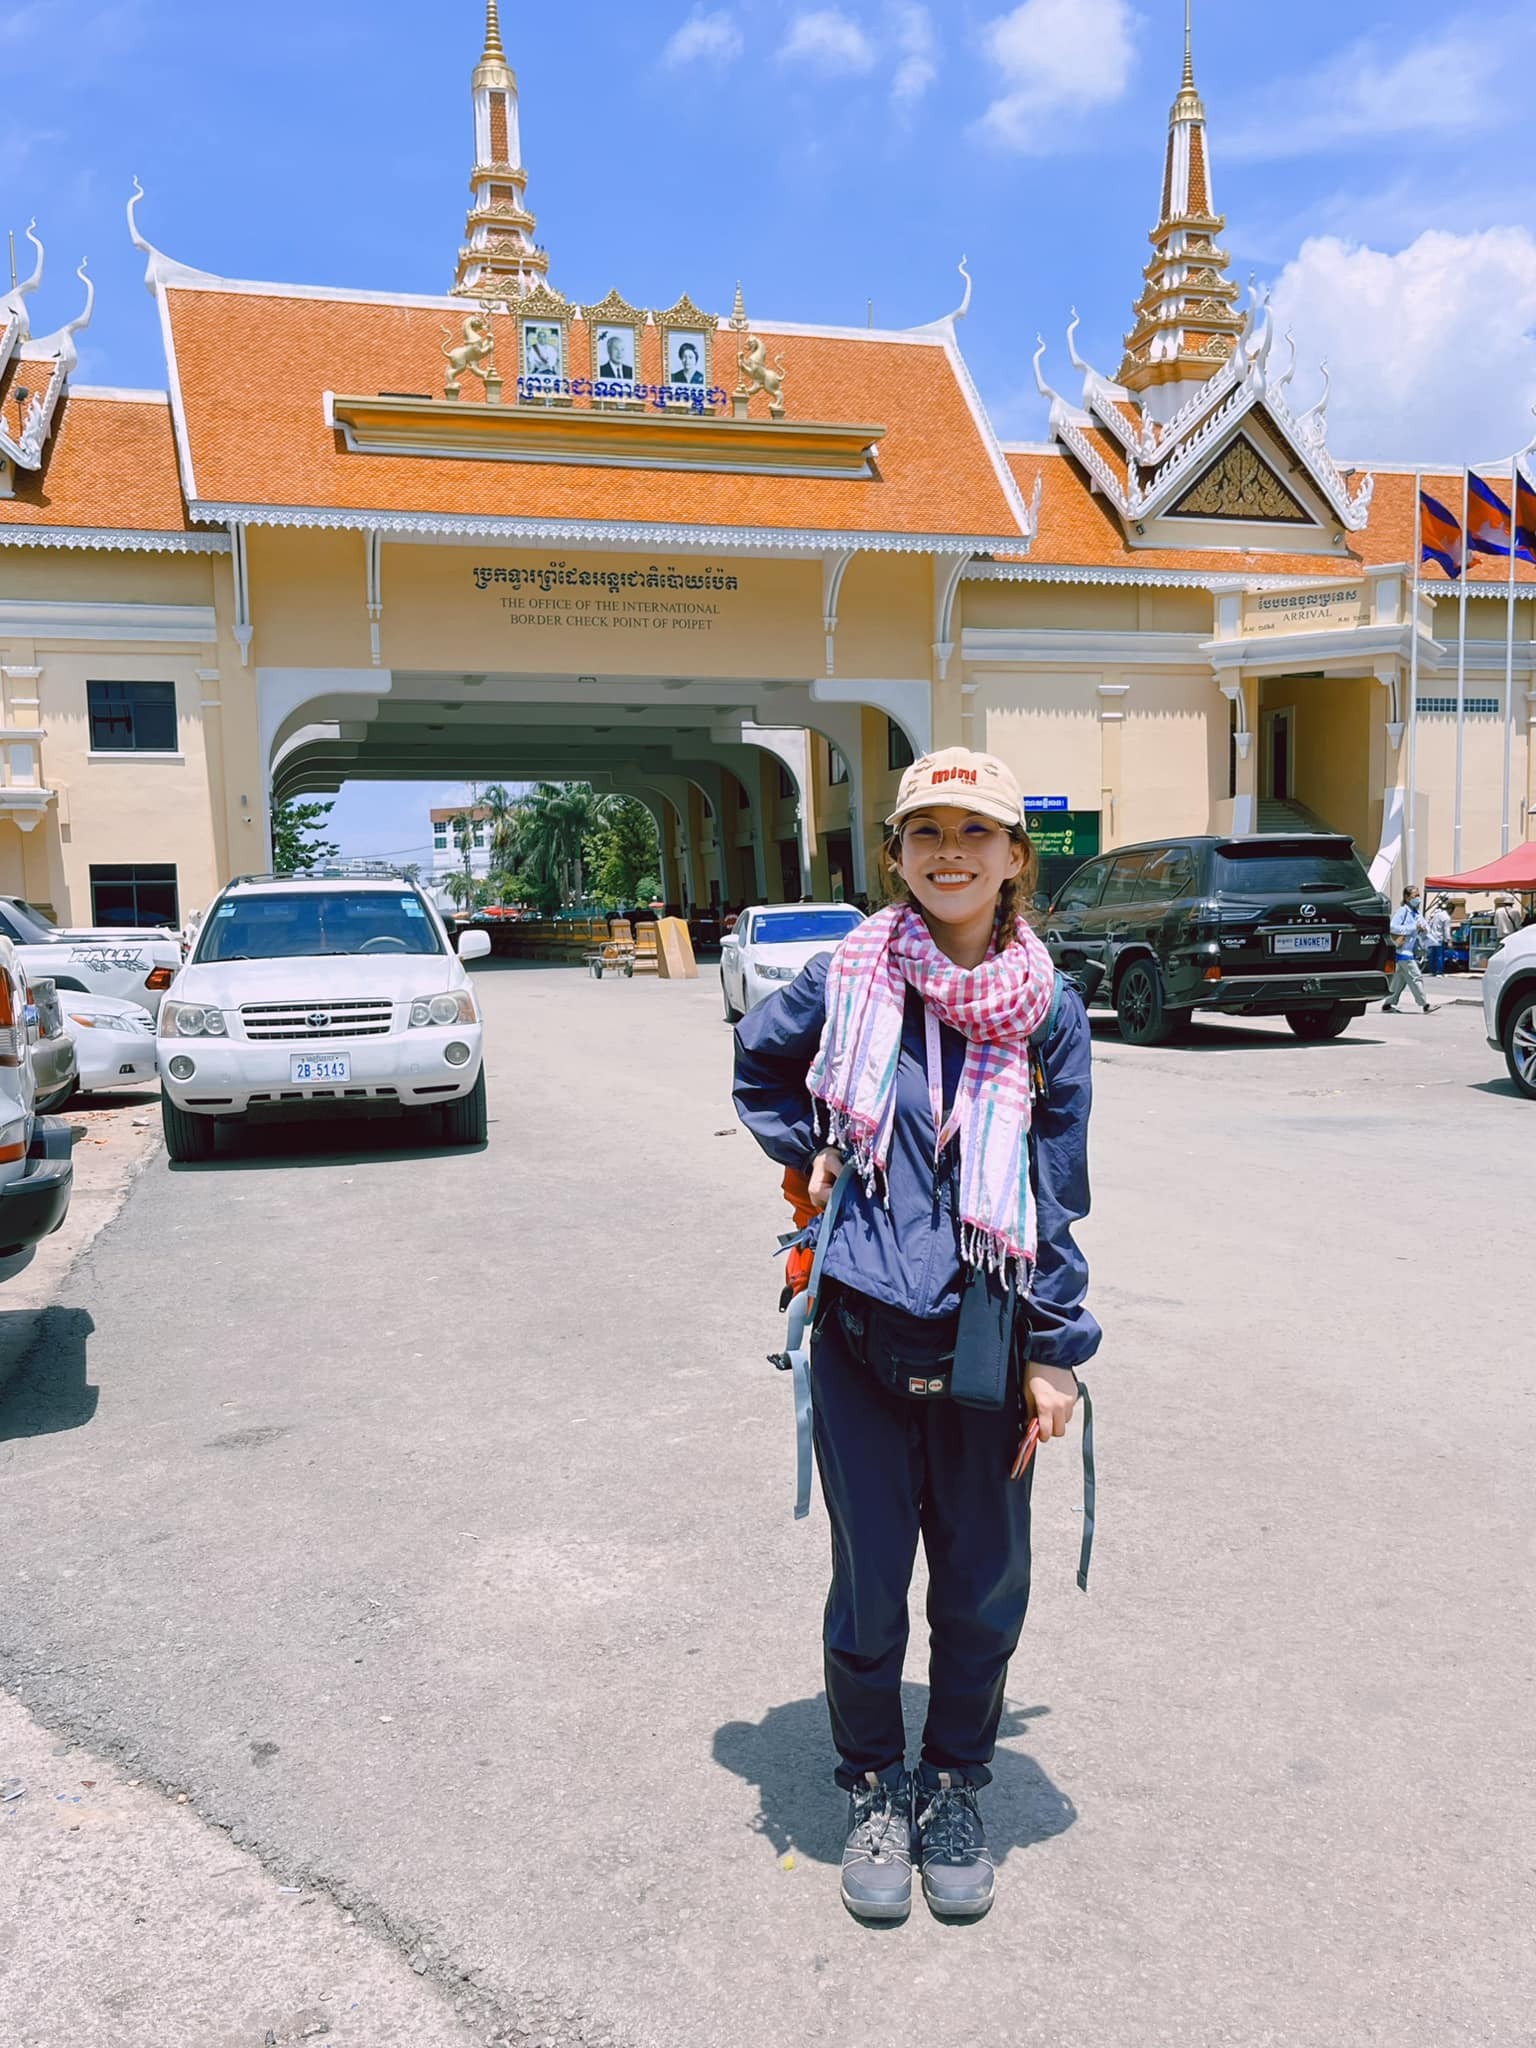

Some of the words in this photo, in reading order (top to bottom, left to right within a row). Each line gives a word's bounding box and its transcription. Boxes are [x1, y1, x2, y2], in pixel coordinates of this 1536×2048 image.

[500, 597, 526, 609] THE
[529, 598, 572, 610] OFFICE
[575, 599, 591, 611] OF
[594, 600, 620, 612] THE
[622, 601, 720, 615] INTERNATIONAL
[510, 614, 563, 626] BORDER
[566, 615, 608, 628] CHECK
[613, 616, 649, 629] POINT
[653, 617, 668, 629] OF
[672, 618, 713, 630] POIPET
[1283, 608, 1333, 622] ARRIVAL
[68, 947, 143, 963] RALLY
[297, 1063, 345, 1078] 2B-5143
